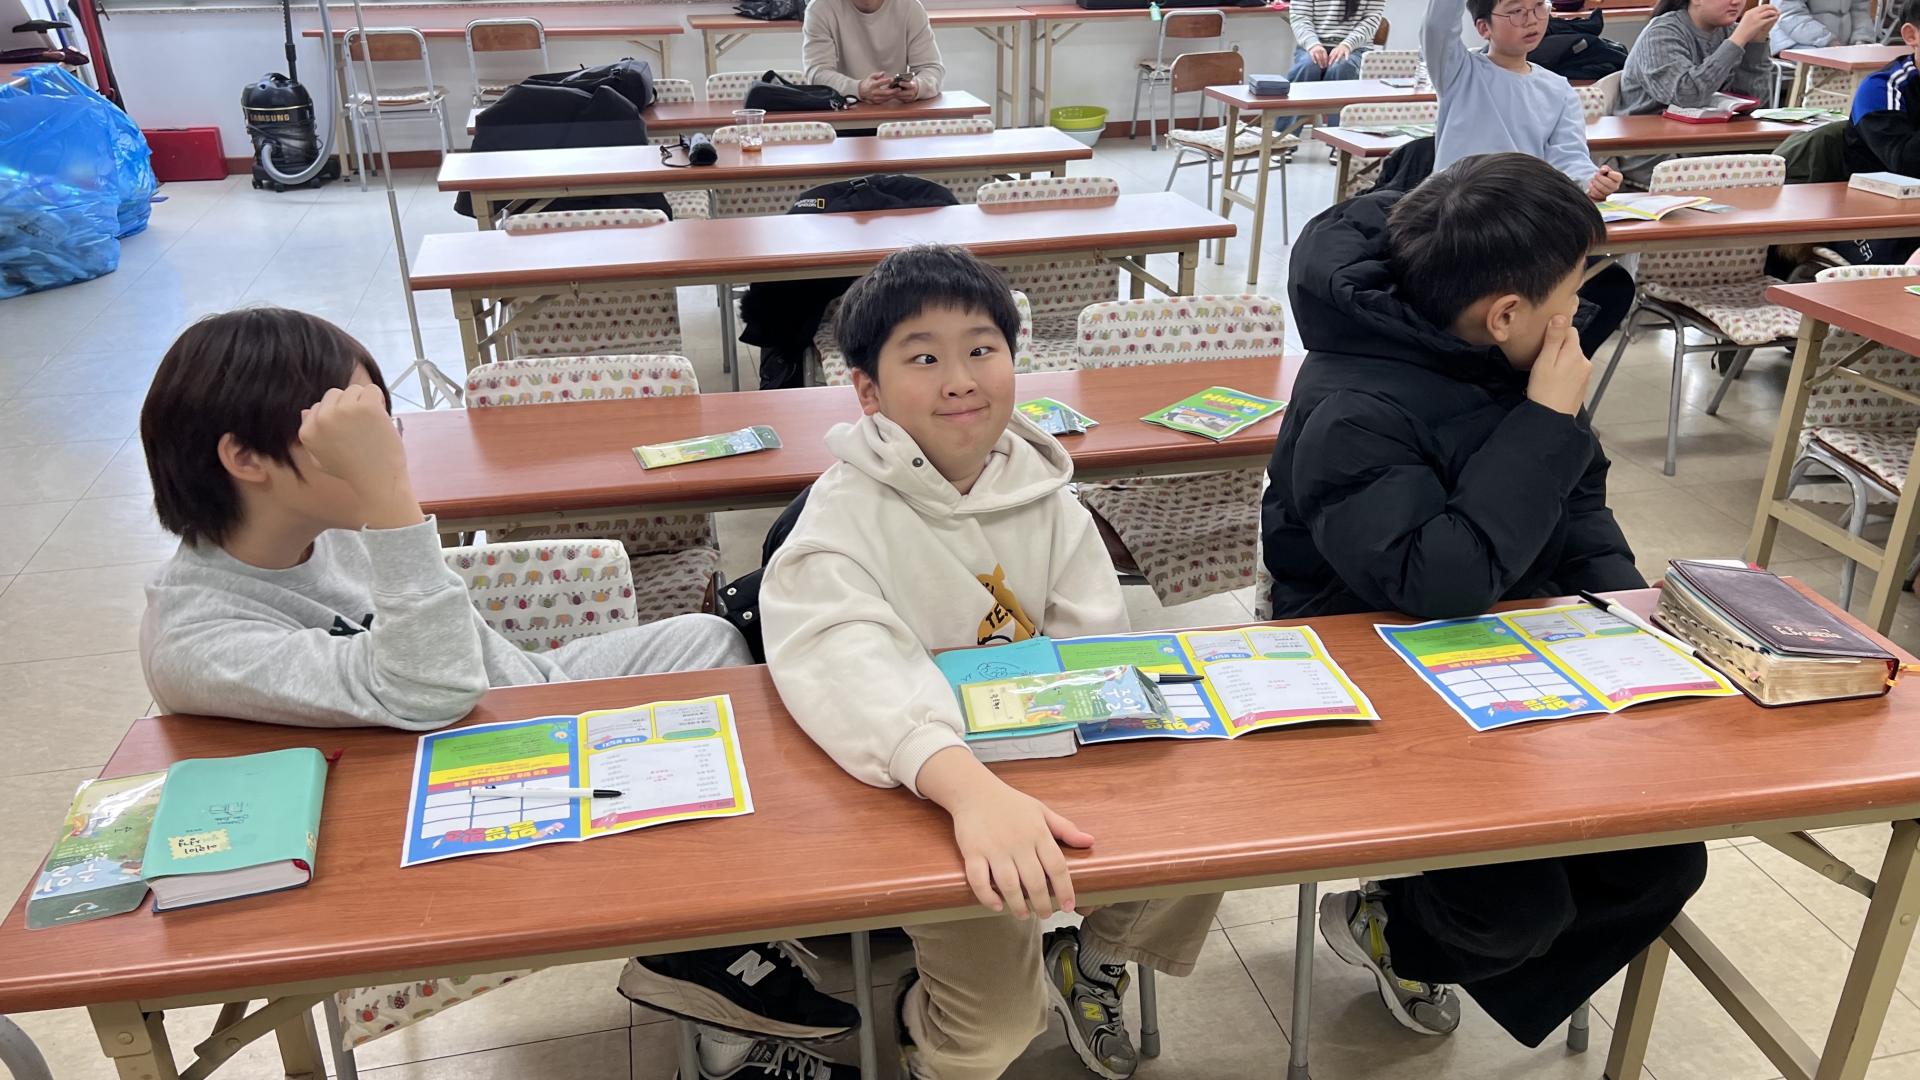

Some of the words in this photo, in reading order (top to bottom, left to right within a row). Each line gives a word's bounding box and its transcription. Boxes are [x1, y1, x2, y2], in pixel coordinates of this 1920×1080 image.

[249, 113, 290, 122] SAMSUNG
[178, 837, 200, 848] 성경
[183, 843, 217, 856] 어린이
[726, 949, 777, 987] N
[1080, 1002, 1105, 1022] N
